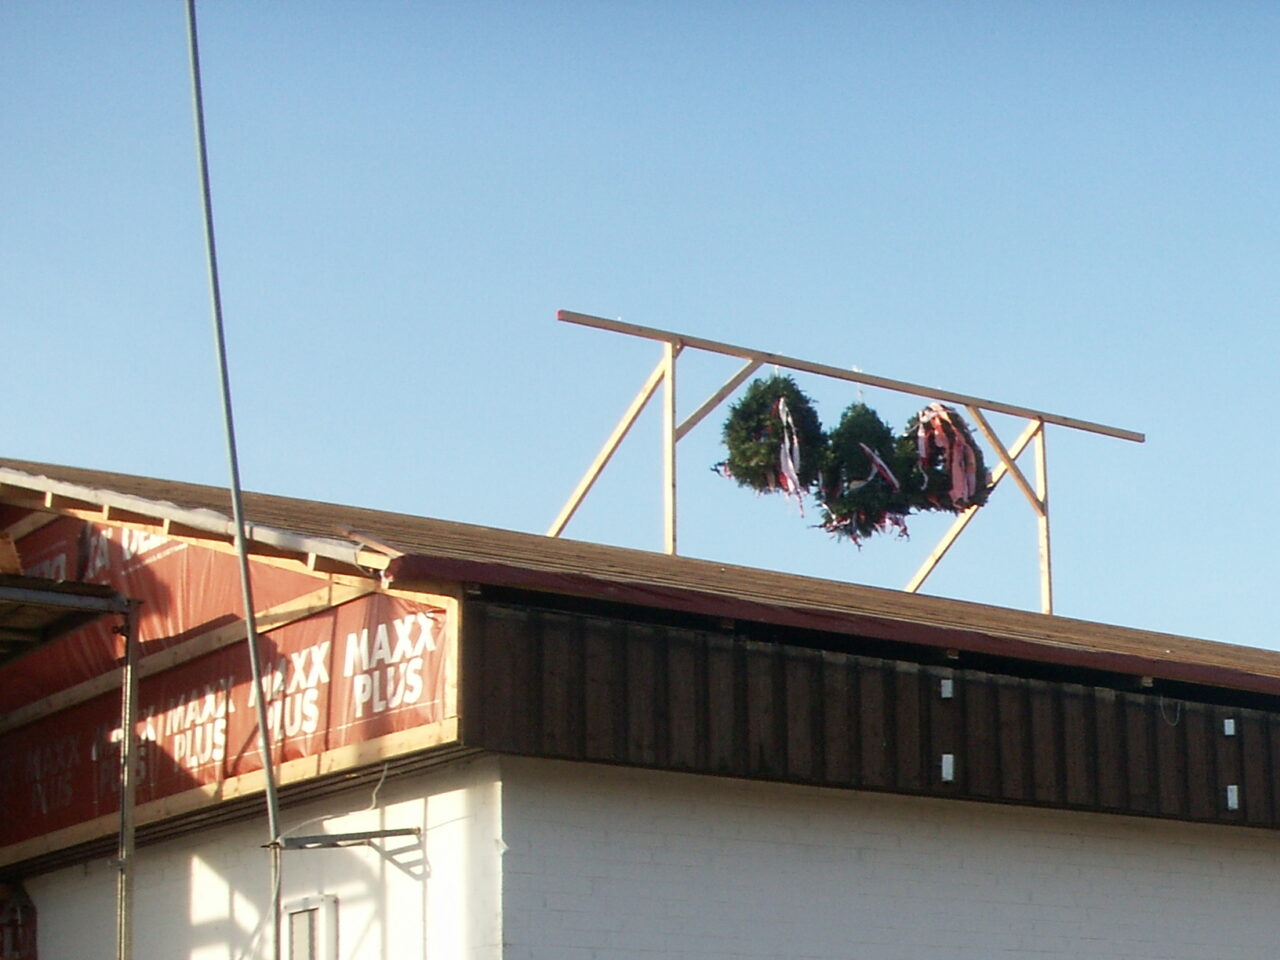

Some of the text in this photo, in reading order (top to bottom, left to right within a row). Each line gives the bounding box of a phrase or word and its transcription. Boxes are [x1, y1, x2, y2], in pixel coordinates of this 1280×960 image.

[247, 640, 331, 707] MAXX
[343, 611, 437, 678] MAXX
[165, 674, 236, 736] MAXX
[353, 657, 424, 709] PLUS
[174, 718, 227, 773] PLUS
